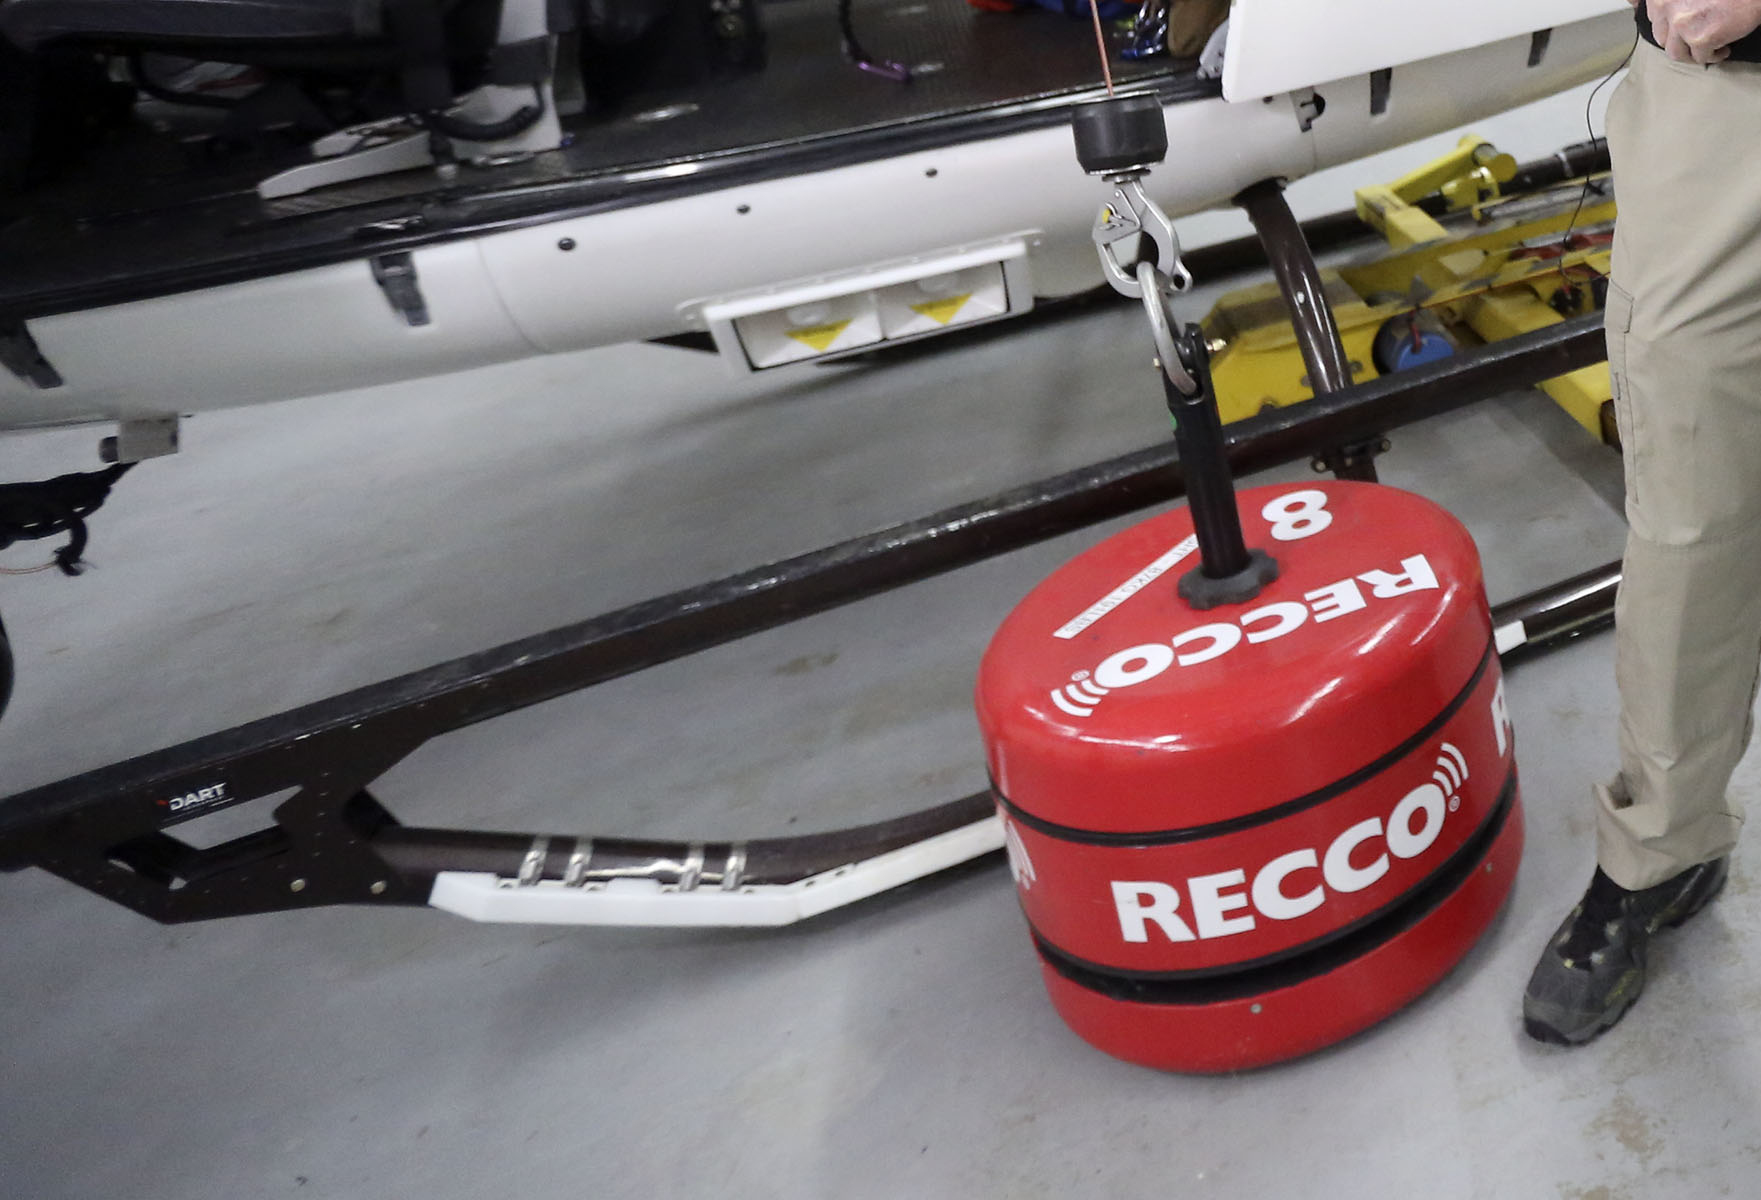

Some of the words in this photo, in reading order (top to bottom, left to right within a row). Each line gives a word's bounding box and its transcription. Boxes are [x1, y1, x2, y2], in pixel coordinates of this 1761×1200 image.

[1262, 489, 1333, 541] 8
[1093, 553, 1440, 688] RECCO
[168, 782, 227, 811] DART
[1110, 783, 1447, 943] RECCO
